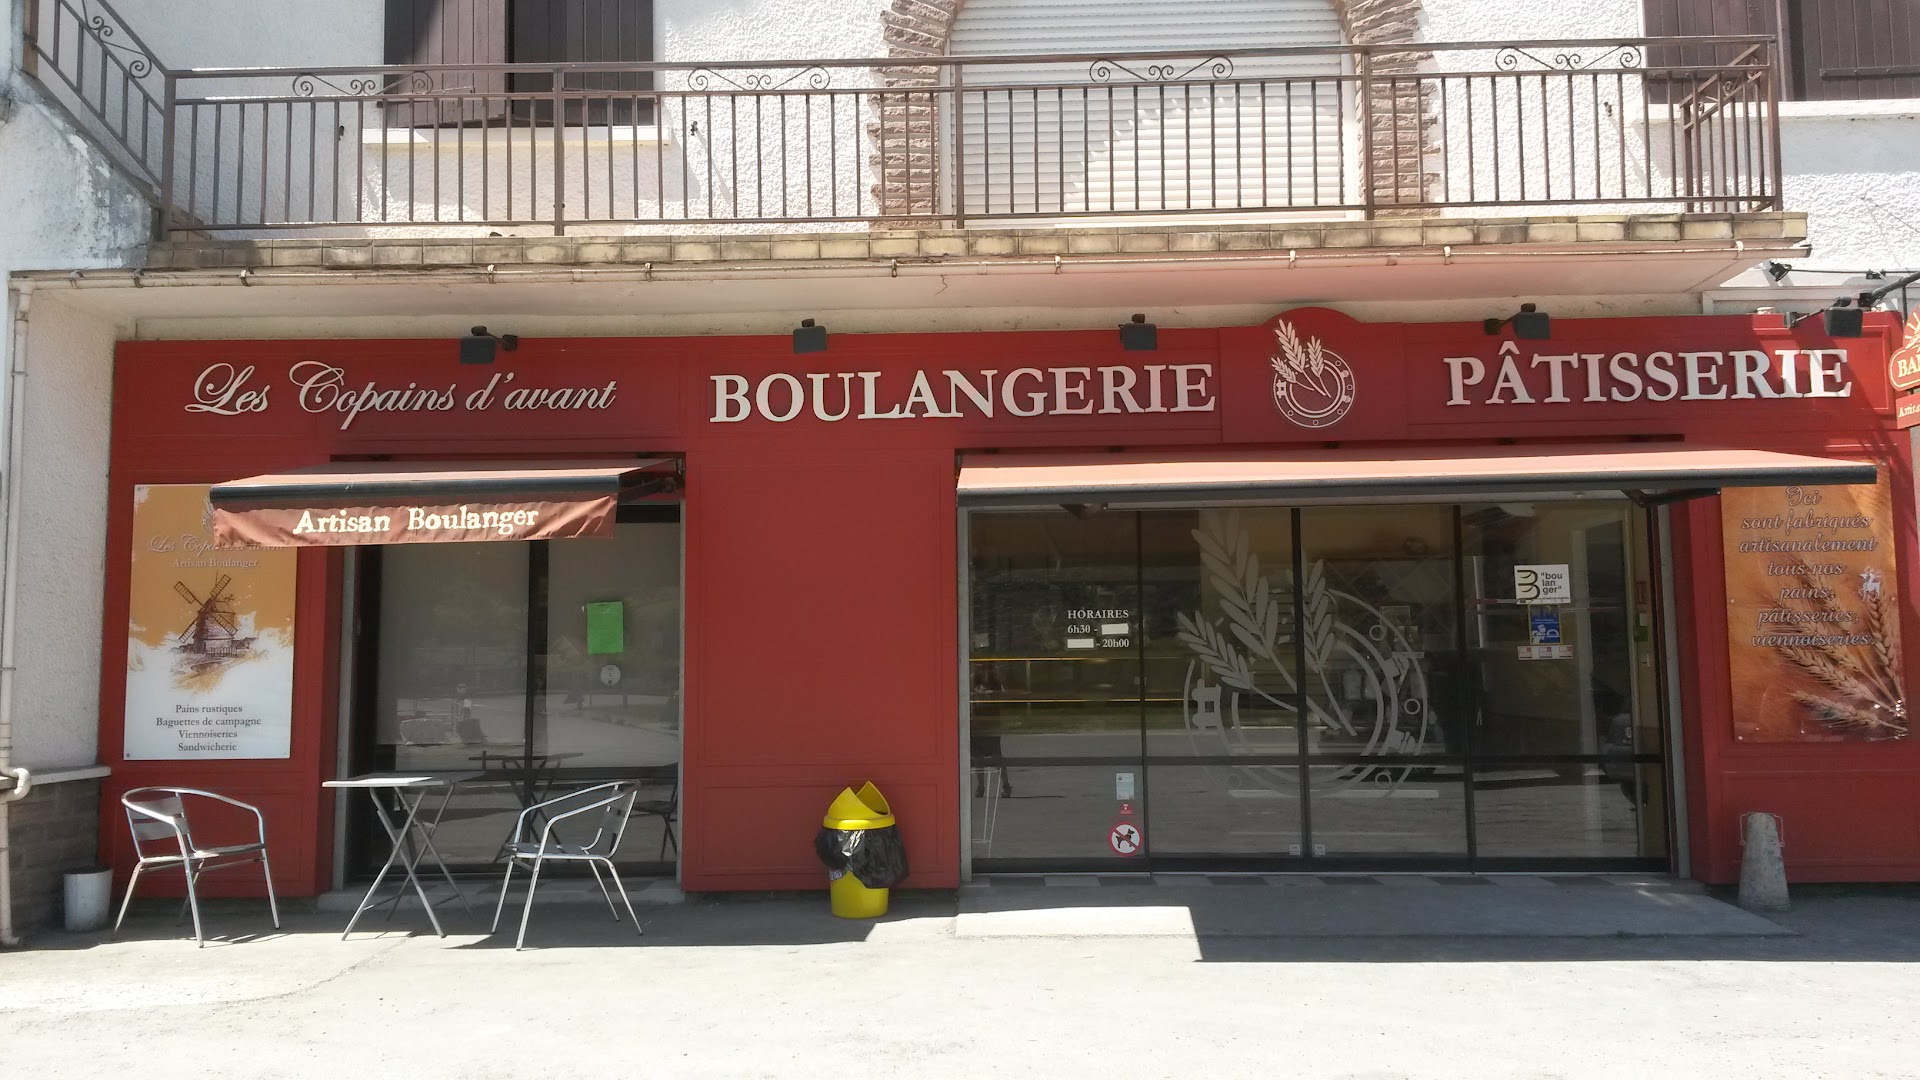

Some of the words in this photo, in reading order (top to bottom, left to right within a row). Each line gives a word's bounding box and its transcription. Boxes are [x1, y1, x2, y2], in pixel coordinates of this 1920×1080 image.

[1443, 340, 1852, 406] PÂTISSERIE
[184, 362, 271, 417] Les
[289, 360, 457, 431] Copains
[465, 371, 618, 411] d'avant
[709, 363, 1216, 423] BOULANGERIE
[1786, 485, 1822, 507] Ici
[292, 509, 391, 535] Artisan
[407, 506, 539, 535] Boulanger
[1741, 514, 1782, 529] sont
[1785, 509, 1873, 535] fabriqués
[148, 535, 176, 553] Les
[1739, 533, 1878, 553] artisanalement
[173, 558, 207, 568] Artisan
[209, 557, 258, 569] Boulanger
[1768, 561, 1807, 577] tous
[1811, 563, 1845, 577] nos
[1067, 609, 1129, 619] HORAIRES
[1757, 609, 1859, 629] pâtisseries,
[1067, 624, 1091, 634] 6h30
[1102, 638, 1130, 648] 20h00
[175, 704, 200, 713] Pains
[202, 704, 243, 716] rustiques
[156, 717, 200, 729] Baguettes
[202, 717, 213, 726] de
[215, 717, 262, 728] campagne
[178, 730, 238, 739] Viennoiseries
[178, 742, 237, 752] Sandwicherie
